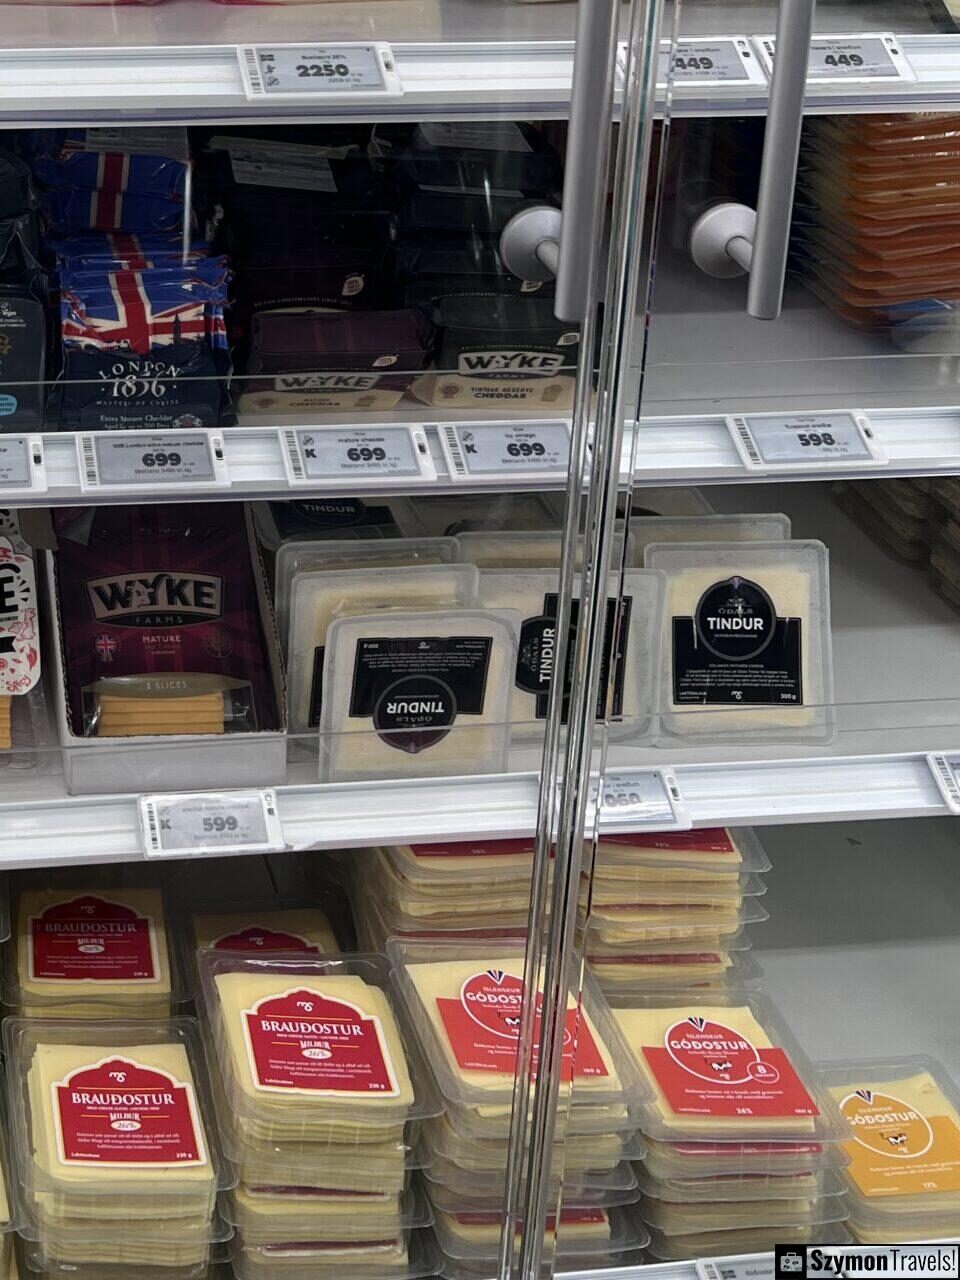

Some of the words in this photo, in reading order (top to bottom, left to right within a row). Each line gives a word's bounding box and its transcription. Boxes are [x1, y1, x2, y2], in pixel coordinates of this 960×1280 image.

[674, 56, 713, 70] 449
[824, 53, 864, 68] 449
[295, 63, 350, 78] 2250
[464, 352, 563, 370] WYKE
[279, 375, 375, 389] WYKE
[473, 392, 528, 400] CHEDDAR
[797, 432, 837, 448] 598
[347, 447, 386, 462] 699
[506, 443, 546, 458] 699
[142, 452, 182, 467] 699
[301, 503, 356, 514] TINDUR
[91, 574, 218, 613] WYKE
[706, 617, 764, 631] TINDUR
[141, 634, 182, 644] MATURE
[539, 626, 556, 684] TINDUR
[386, 702, 446, 715] TINDUR
[202, 815, 239, 832] 599
[669, 1038, 750, 1051] GÓÐOSTUR
[757, 1064, 767, 1074] 8
